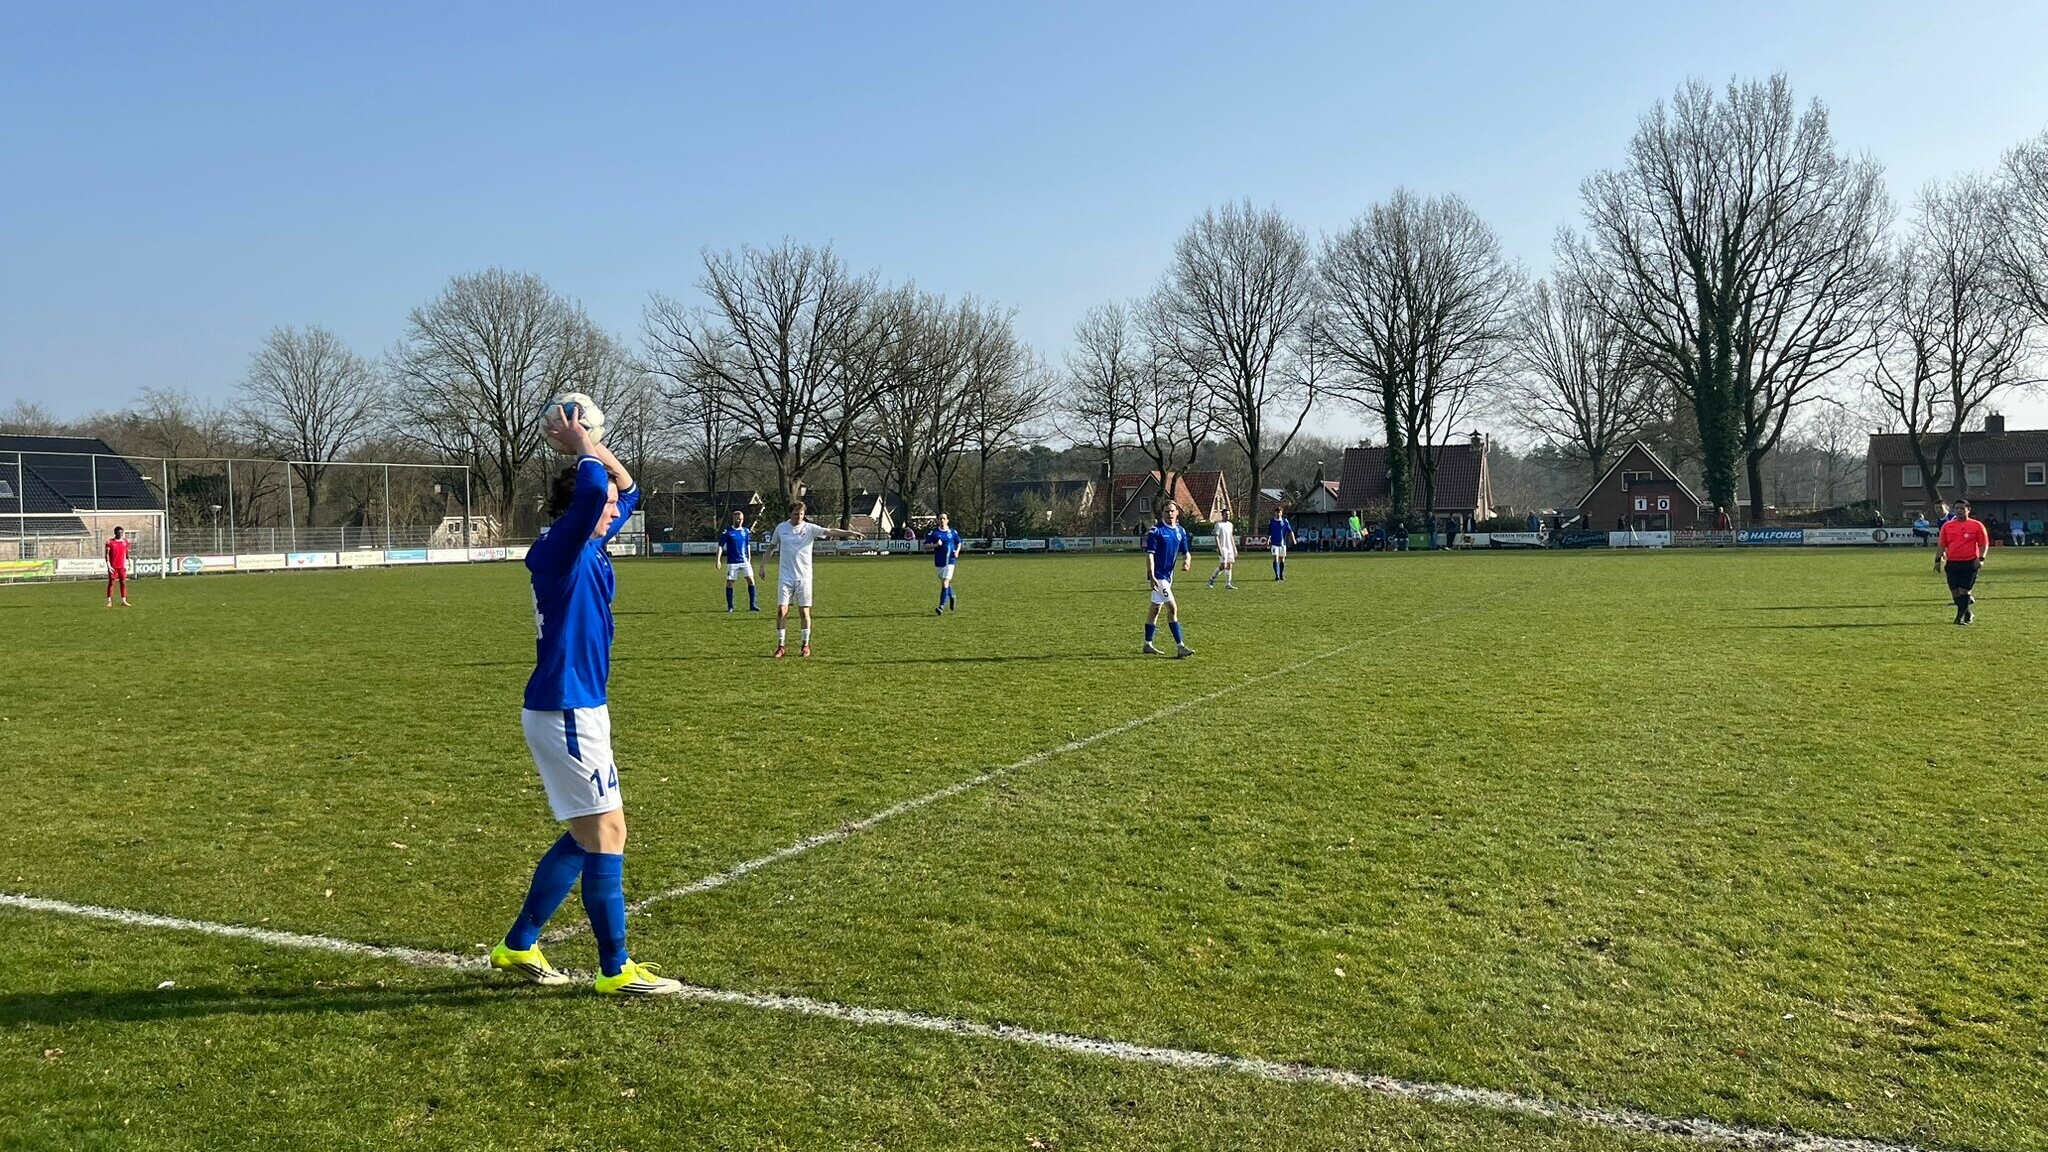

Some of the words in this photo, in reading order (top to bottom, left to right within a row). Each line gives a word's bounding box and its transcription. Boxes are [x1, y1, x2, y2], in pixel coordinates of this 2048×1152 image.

[1638, 500, 1643, 509] 1
[1660, 499, 1668, 509] 0
[1750, 531, 1802, 539] HALFORDS
[1162, 588, 1169, 598] 5
[590, 764, 618, 797] 14
